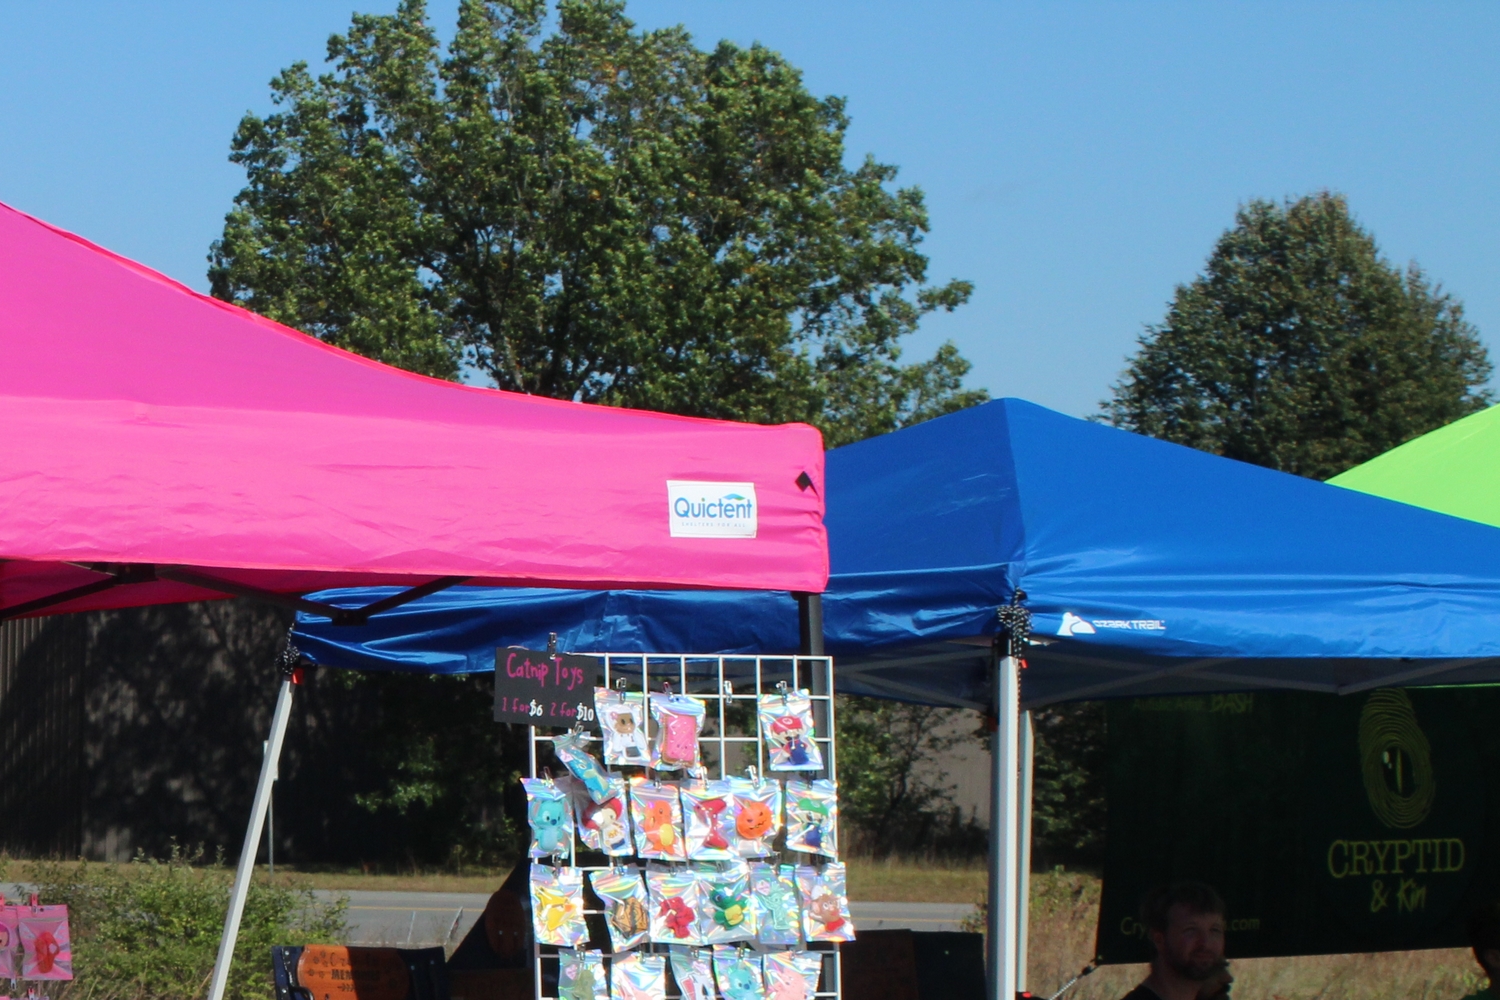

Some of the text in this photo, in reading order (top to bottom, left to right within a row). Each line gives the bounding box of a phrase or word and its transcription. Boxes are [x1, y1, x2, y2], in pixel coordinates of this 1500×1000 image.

[673, 496, 753, 519] Quictent
[1131, 620, 1166, 630] TRAIL
[506, 652, 584, 691] Catnip Toys
[502, 697, 595, 722] 1 for $6 2 for $10
[1327, 838, 1465, 878] CRYPTID
[1370, 878, 1427, 913] & Kin
